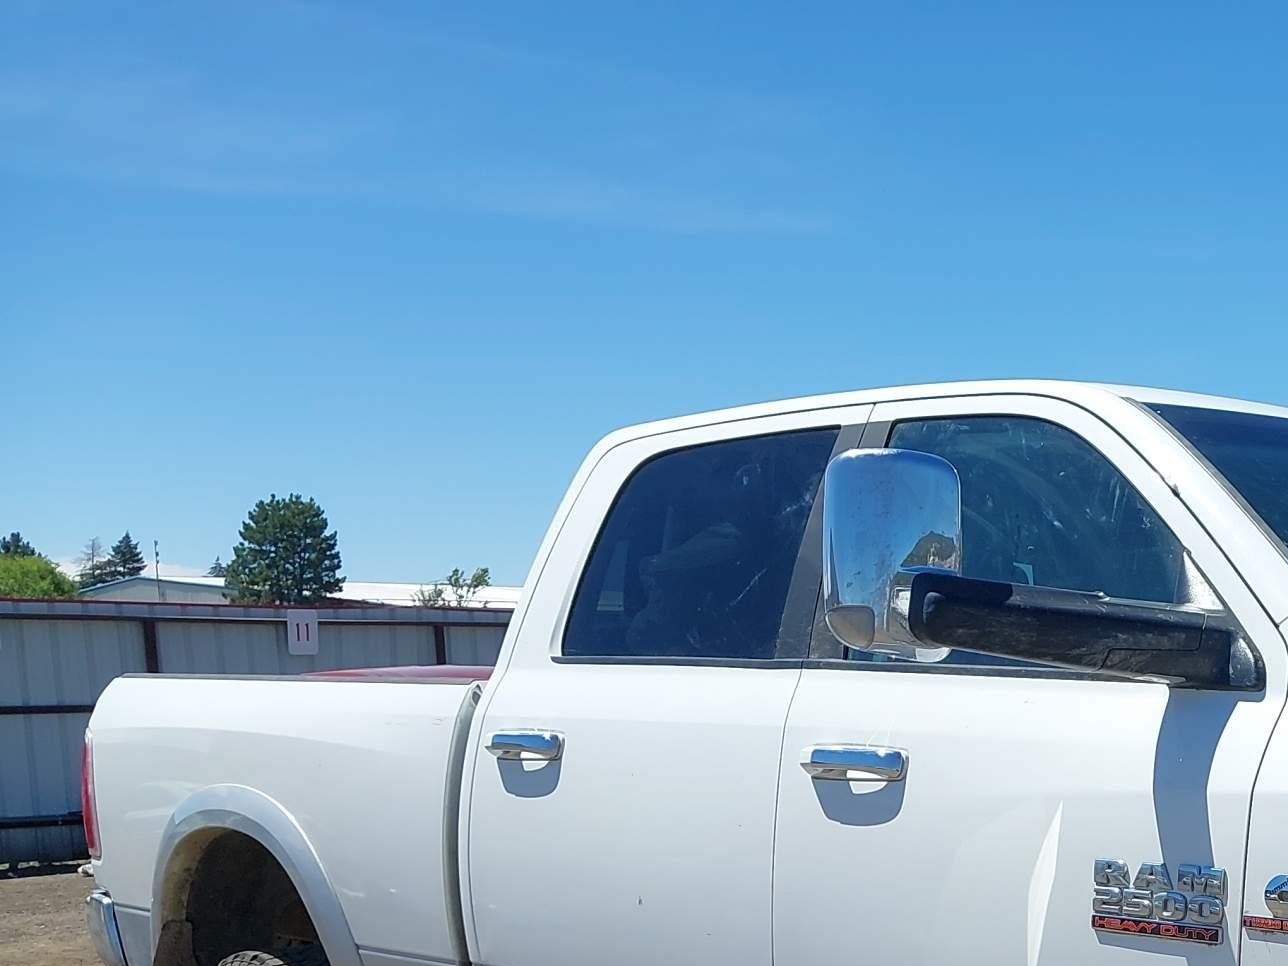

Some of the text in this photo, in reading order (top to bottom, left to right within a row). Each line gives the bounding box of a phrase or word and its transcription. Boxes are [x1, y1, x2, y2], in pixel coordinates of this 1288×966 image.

[295, 623, 310, 642] 11
[1093, 858, 1226, 895] RAM
[1092, 886, 1224, 924] 2500
[1094, 916, 1217, 940] HEAVY DUTY
